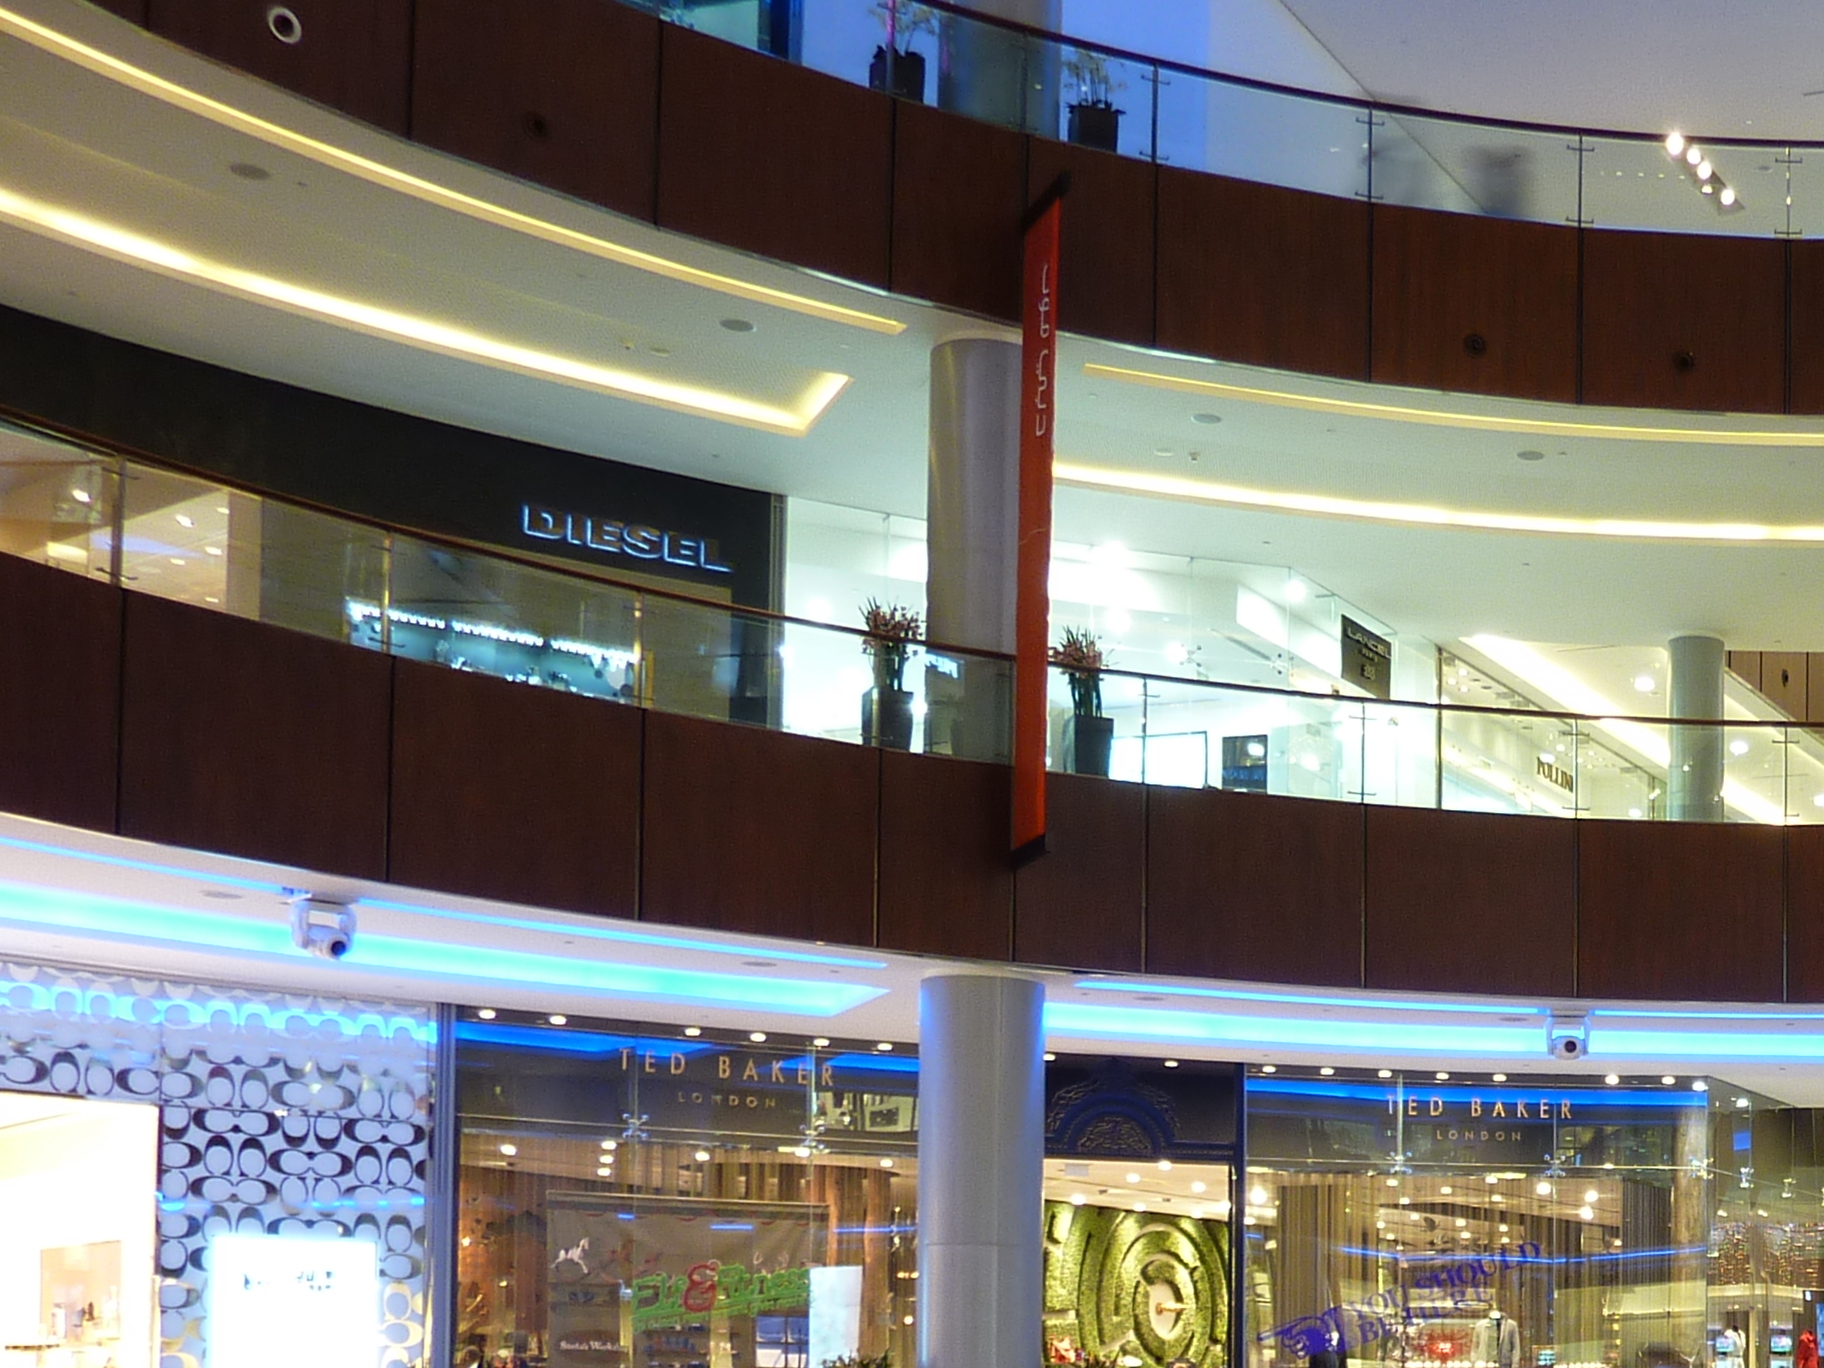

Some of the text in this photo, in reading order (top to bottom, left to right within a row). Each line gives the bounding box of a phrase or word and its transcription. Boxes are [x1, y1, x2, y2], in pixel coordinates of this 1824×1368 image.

[521, 503, 734, 574] DIESEL
[1347, 627, 1392, 659] LANCEL
[619, 1047, 834, 1087] TED BAKER
[677, 1091, 777, 1109] LONDON
[1386, 1094, 1573, 1120] TED BAKER
[1436, 1129, 1523, 1142] LONDON
[1415, 1241, 1542, 1299] SHOULD
